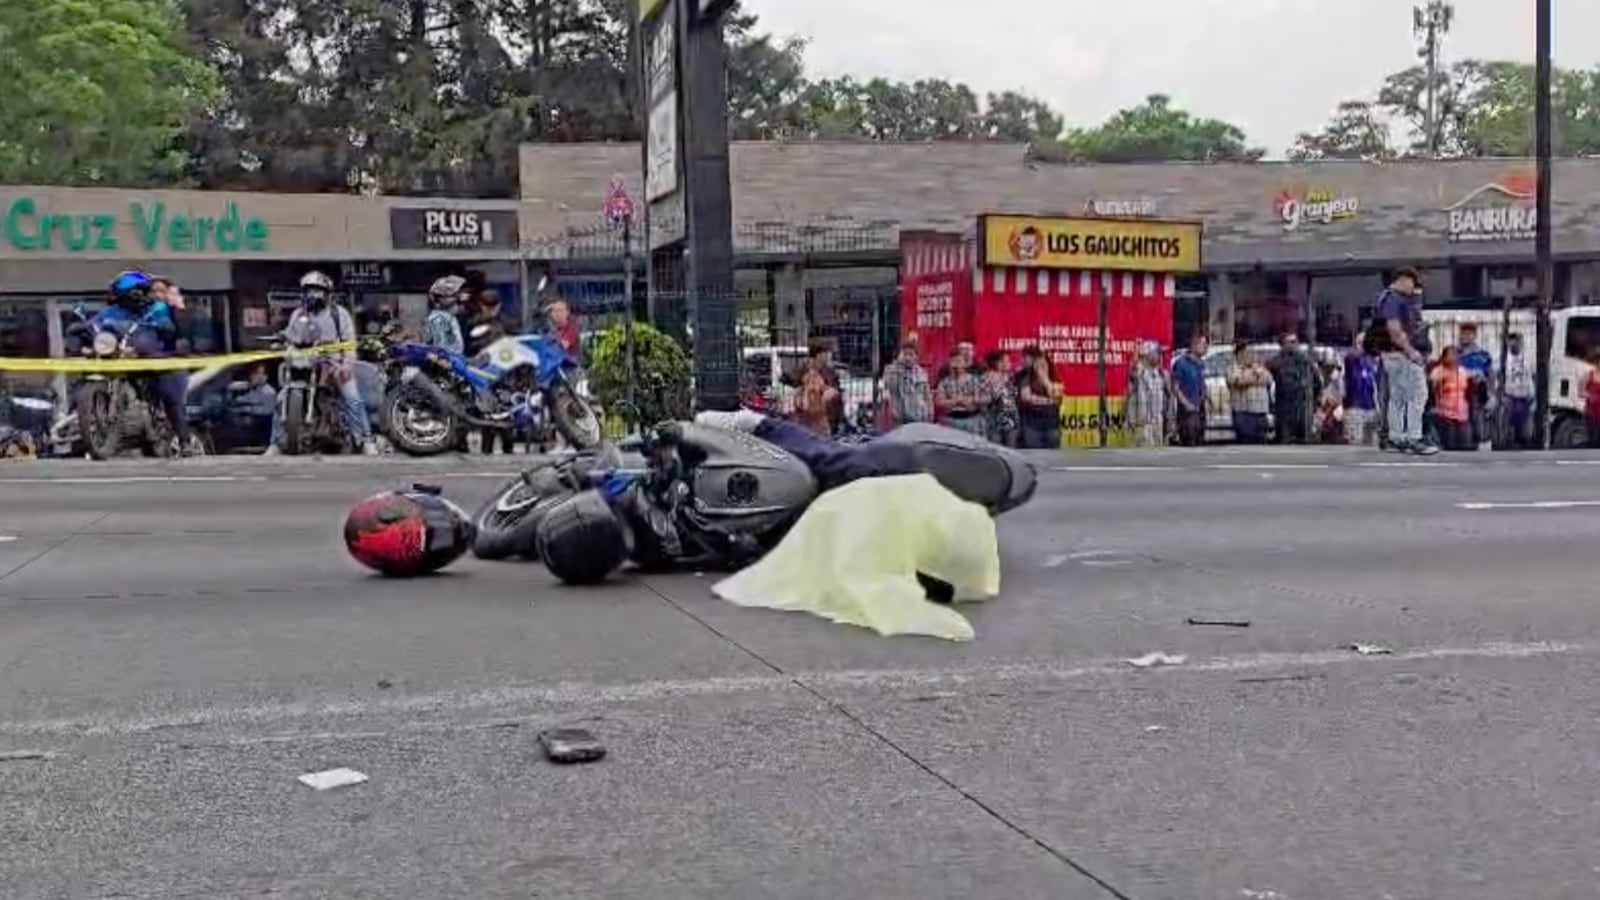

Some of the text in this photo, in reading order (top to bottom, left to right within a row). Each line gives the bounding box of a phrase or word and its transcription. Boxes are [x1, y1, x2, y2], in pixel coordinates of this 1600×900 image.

[5, 197, 268, 250] Cruz Verde
[426, 211, 479, 233] PLUS
[1450, 207, 1537, 233] BANRURA
[1047, 233, 1181, 258] LOS GAUCHITOS
